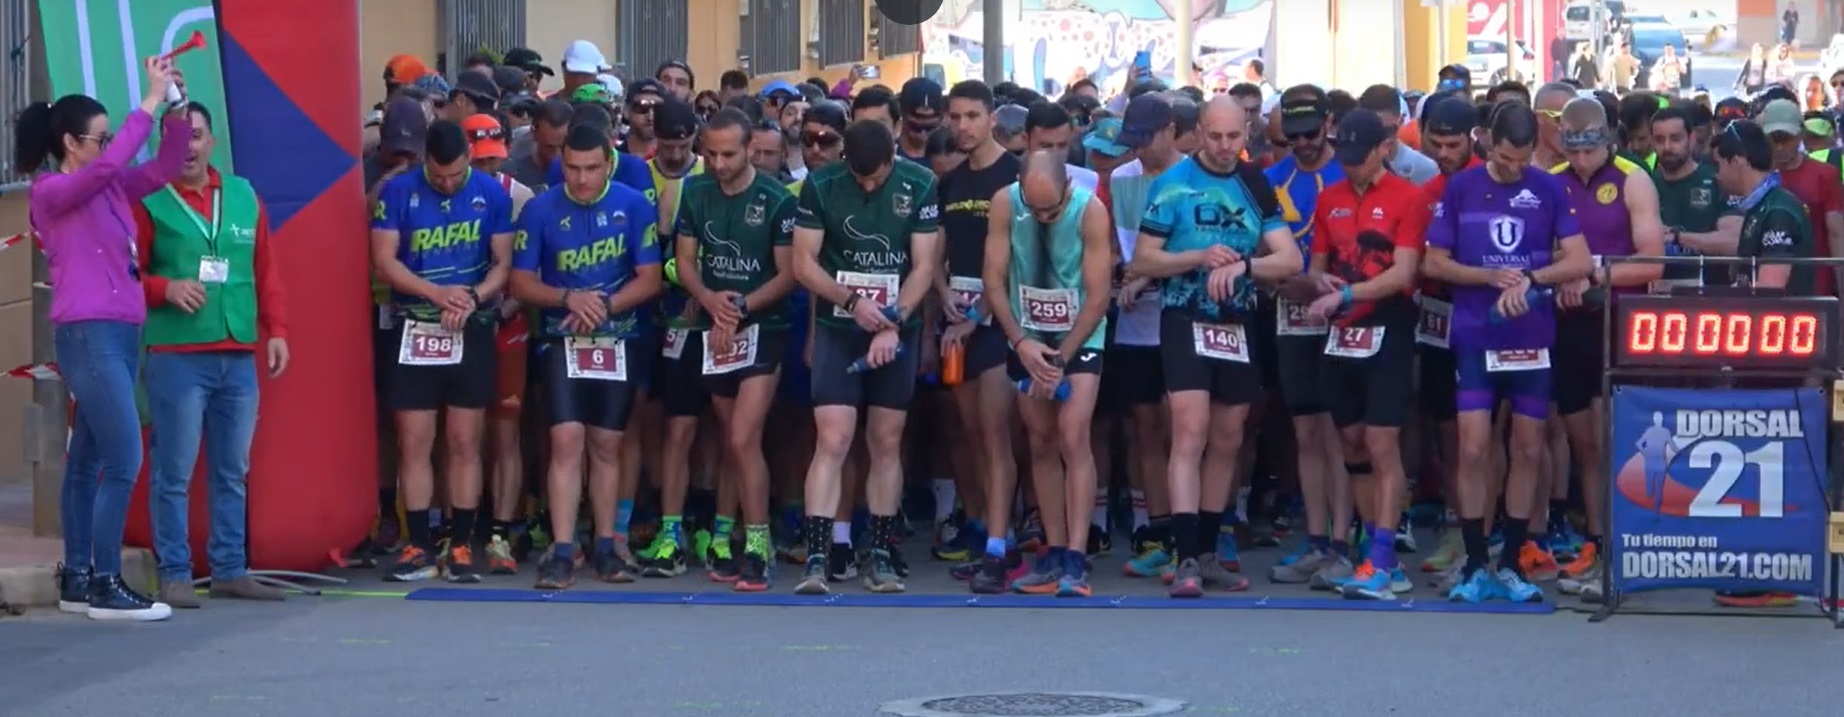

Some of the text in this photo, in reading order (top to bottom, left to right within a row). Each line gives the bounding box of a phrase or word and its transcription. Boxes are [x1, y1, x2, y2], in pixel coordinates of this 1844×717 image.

[411, 218, 481, 252] RAFAL
[514, 230, 528, 250] R
[557, 233, 626, 271] RAFAL
[843, 249, 909, 267] CATALINA
[706, 255, 761, 273] CATALINA
[1031, 302, 1067, 318] 259
[1205, 329, 1238, 348] 140
[1344, 326, 1366, 342] 27
[415, 336, 452, 352] 198
[592, 350, 604, 365] 6
[1676, 409, 1804, 438] DORSAL
[1689, 440, 1784, 518] 21
[1622, 533, 1717, 549] Tu tiempo en
[1622, 551, 1813, 581] DORSAL21.COM
